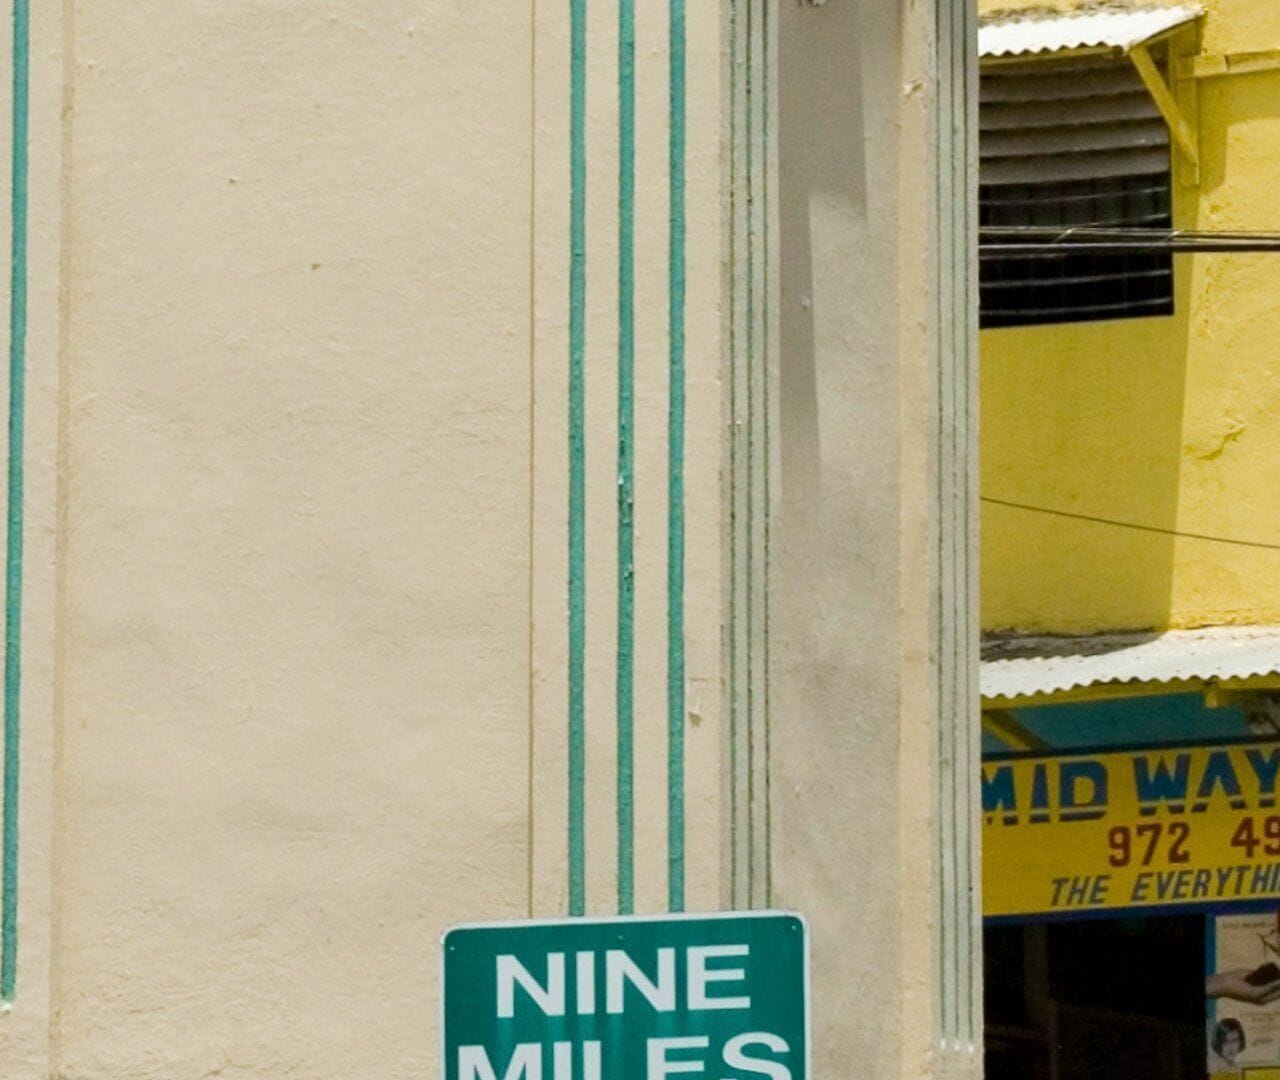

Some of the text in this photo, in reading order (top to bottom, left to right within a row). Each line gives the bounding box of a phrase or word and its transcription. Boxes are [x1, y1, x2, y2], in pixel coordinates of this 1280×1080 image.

[982, 758, 1109, 827] MID
[1107, 821, 1191, 868] 972
[1050, 874, 1111, 907] THE
[495, 944, 752, 1019] NINE
